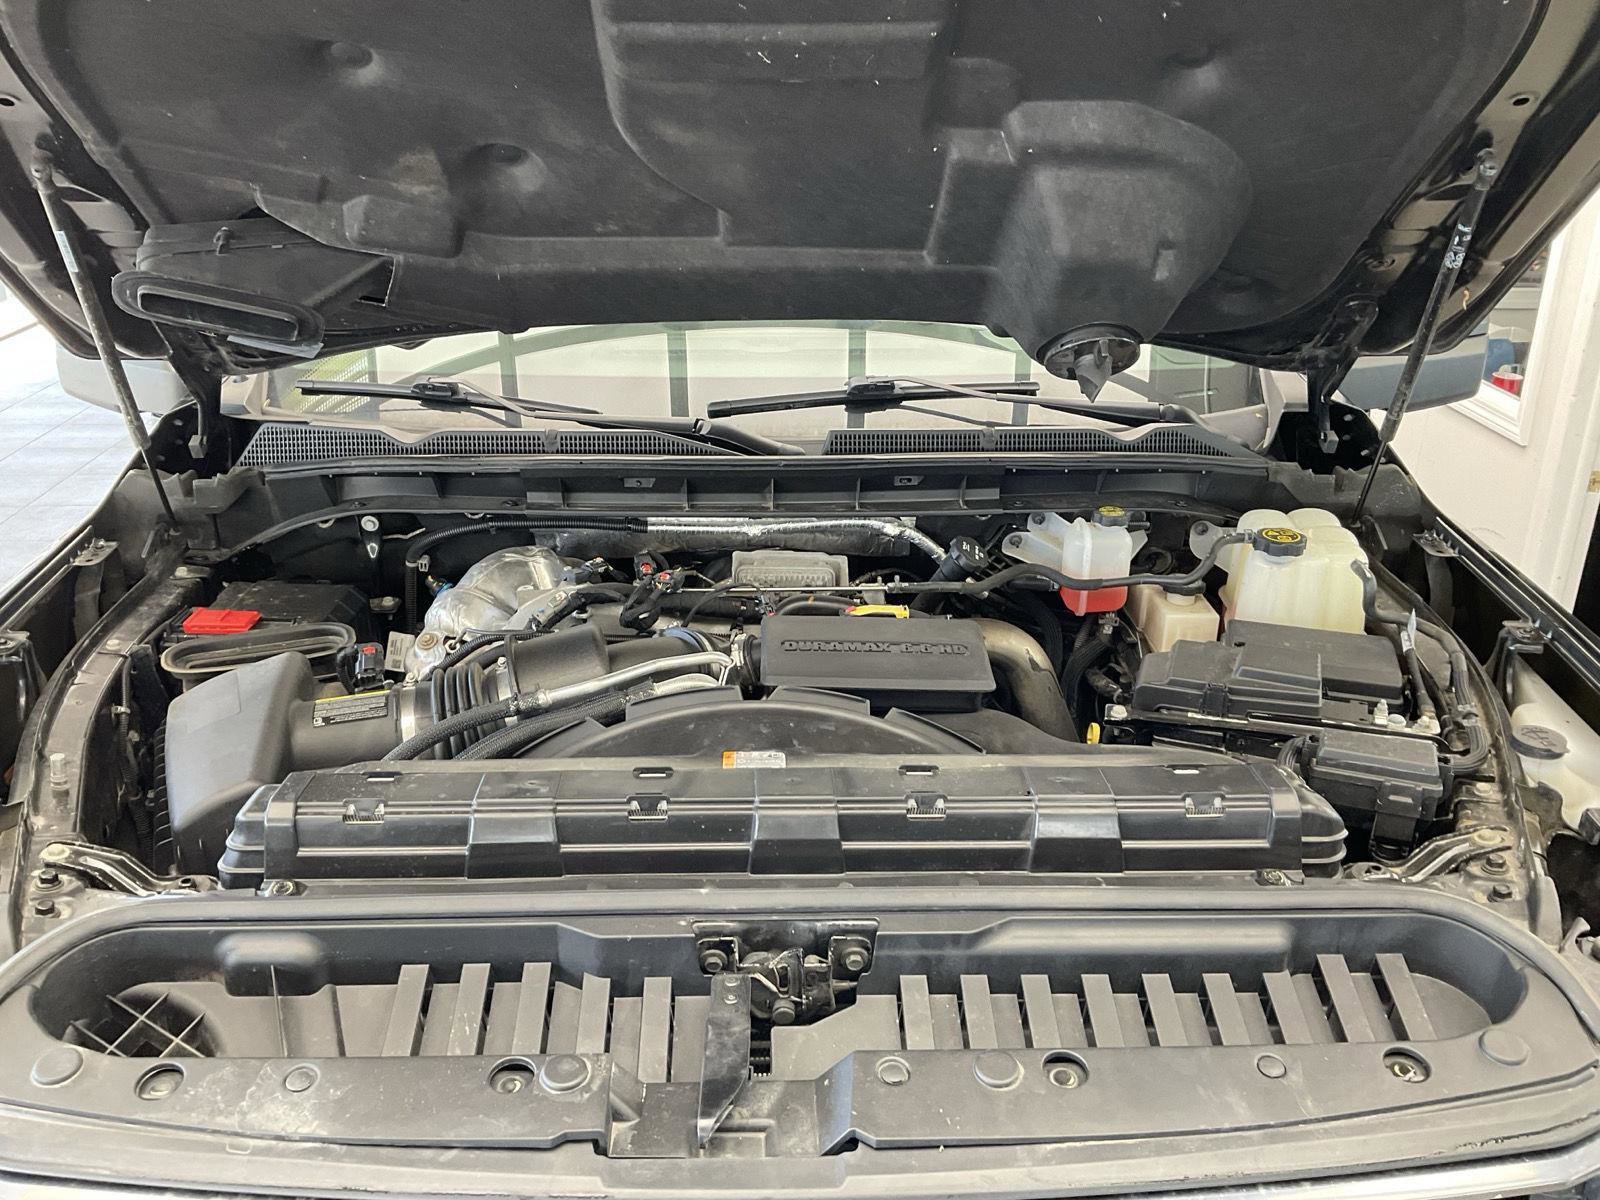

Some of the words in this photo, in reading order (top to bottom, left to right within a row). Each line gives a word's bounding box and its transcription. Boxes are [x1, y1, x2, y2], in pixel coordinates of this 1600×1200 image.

[783, 640, 892, 652] DURAMAX
[900, 642, 933, 654] 6.6
[939, 643, 969, 655] HD
